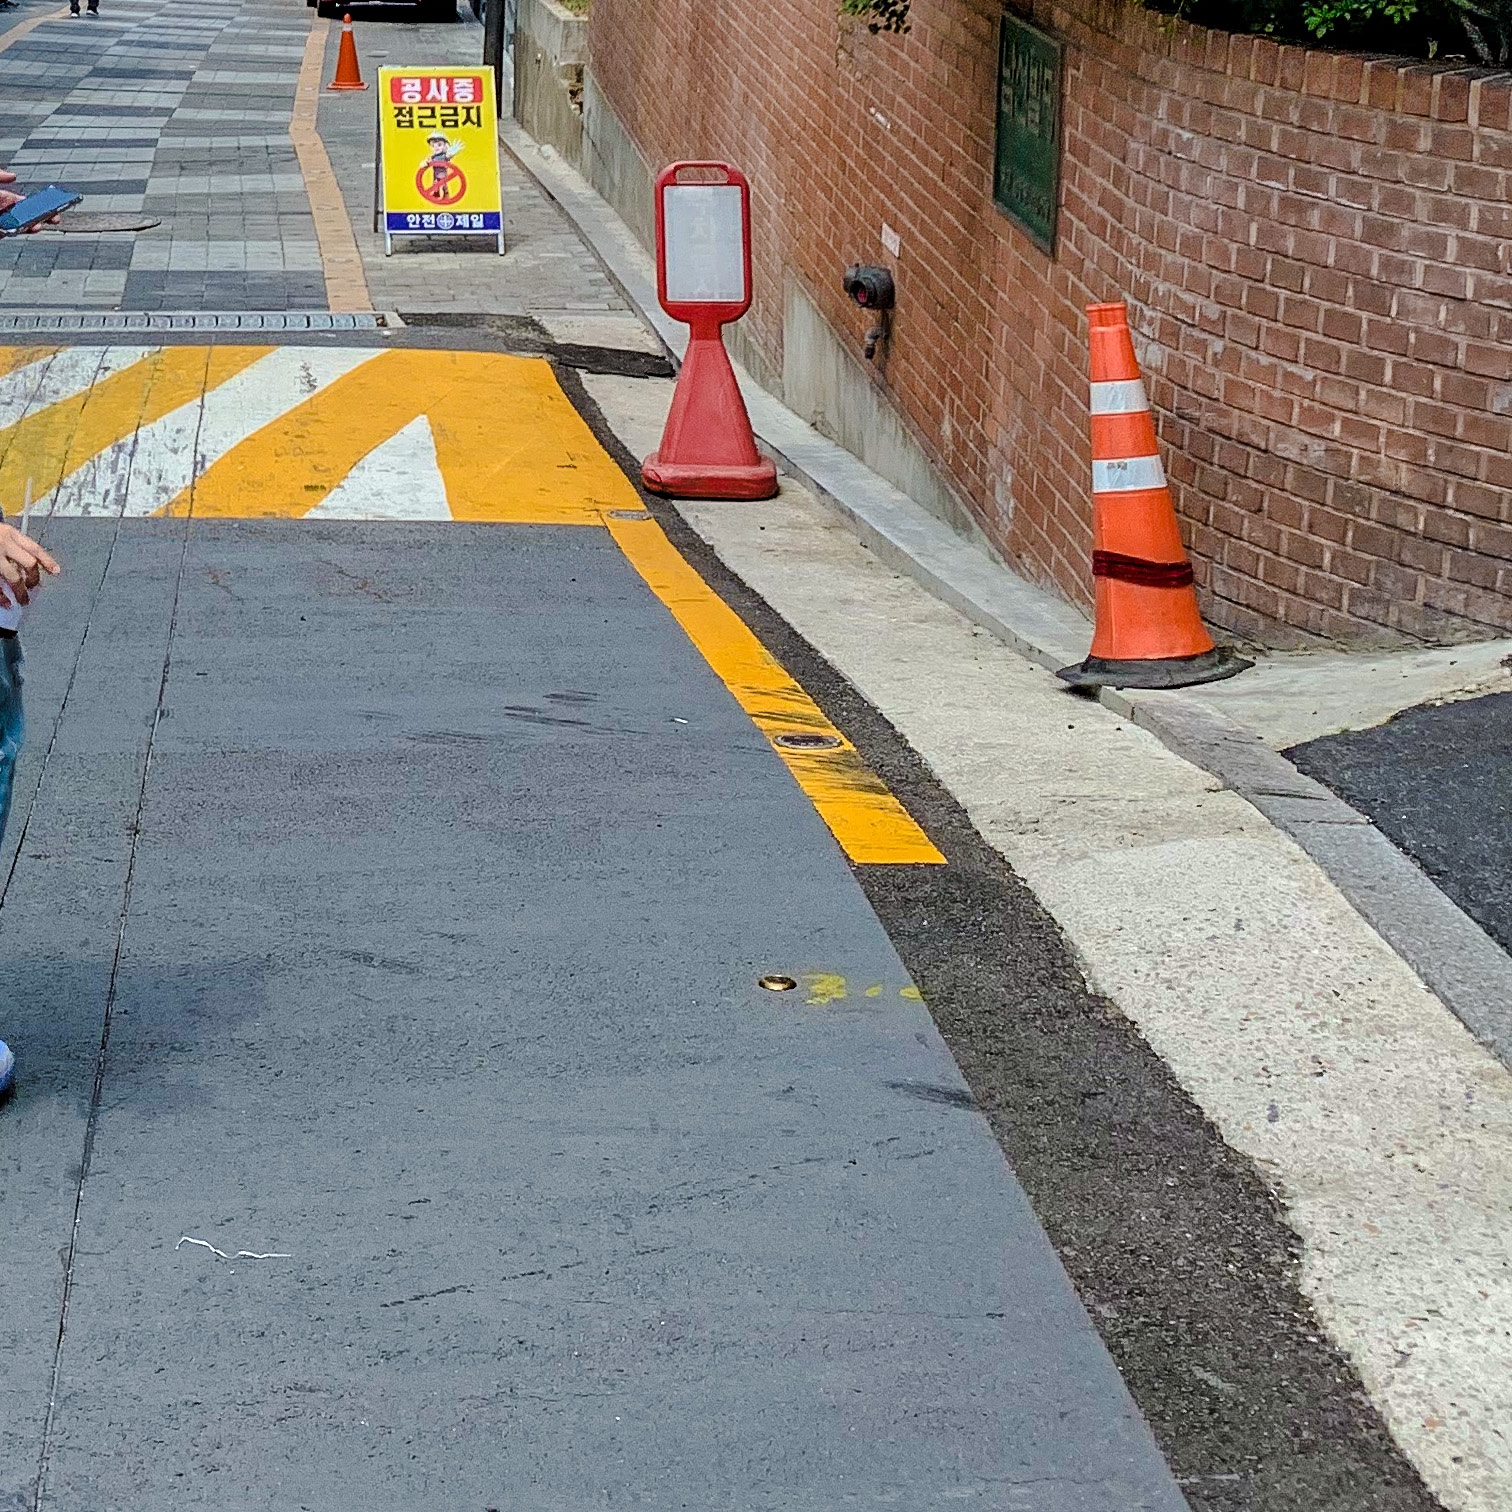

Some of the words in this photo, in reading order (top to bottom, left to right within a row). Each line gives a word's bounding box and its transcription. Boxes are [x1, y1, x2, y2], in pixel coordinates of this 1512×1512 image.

[400, 77, 475, 104] 공사중
[393, 105, 483, 129] 접근금지
[405, 213, 436, 229] 안전
[454, 213, 485, 229] 제일
